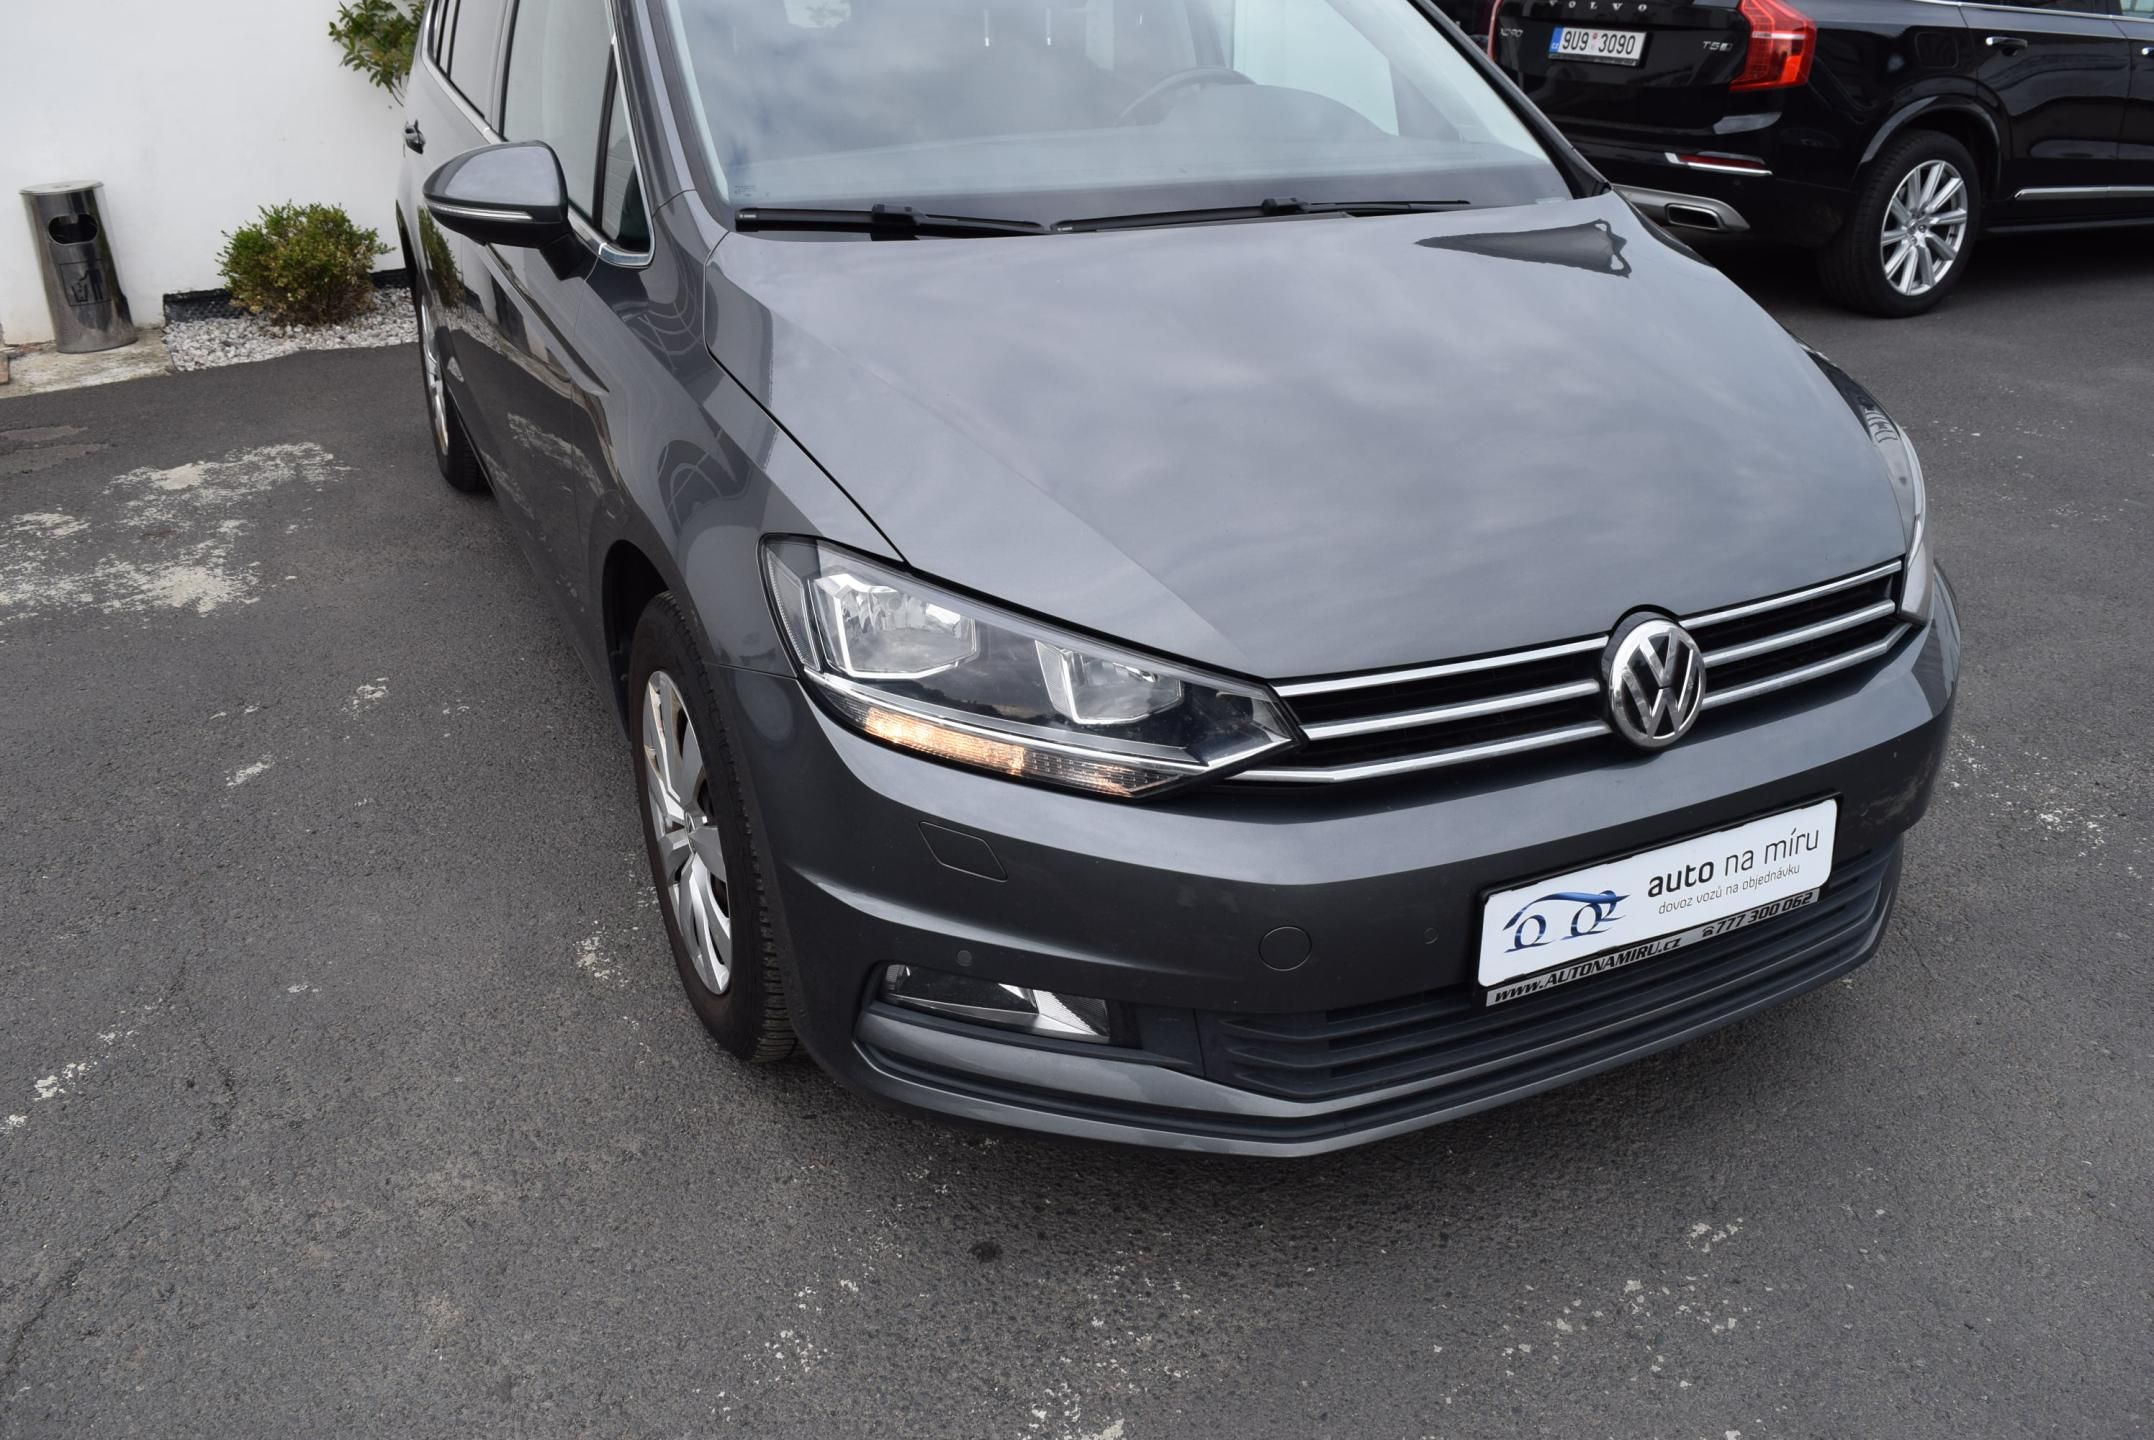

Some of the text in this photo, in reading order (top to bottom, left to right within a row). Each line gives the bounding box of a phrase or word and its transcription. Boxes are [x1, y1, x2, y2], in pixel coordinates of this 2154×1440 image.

[1562, 30, 1636, 55] 9U9 3090
[1647, 827, 1819, 898] auto na míru
[1658, 897, 1693, 915] dovoz
[1725, 883, 1739, 896] na
[1742, 864, 1801, 893] objednávku
[1494, 891, 1814, 1003] www.AUTONAMIRU.cz 777 300 062
